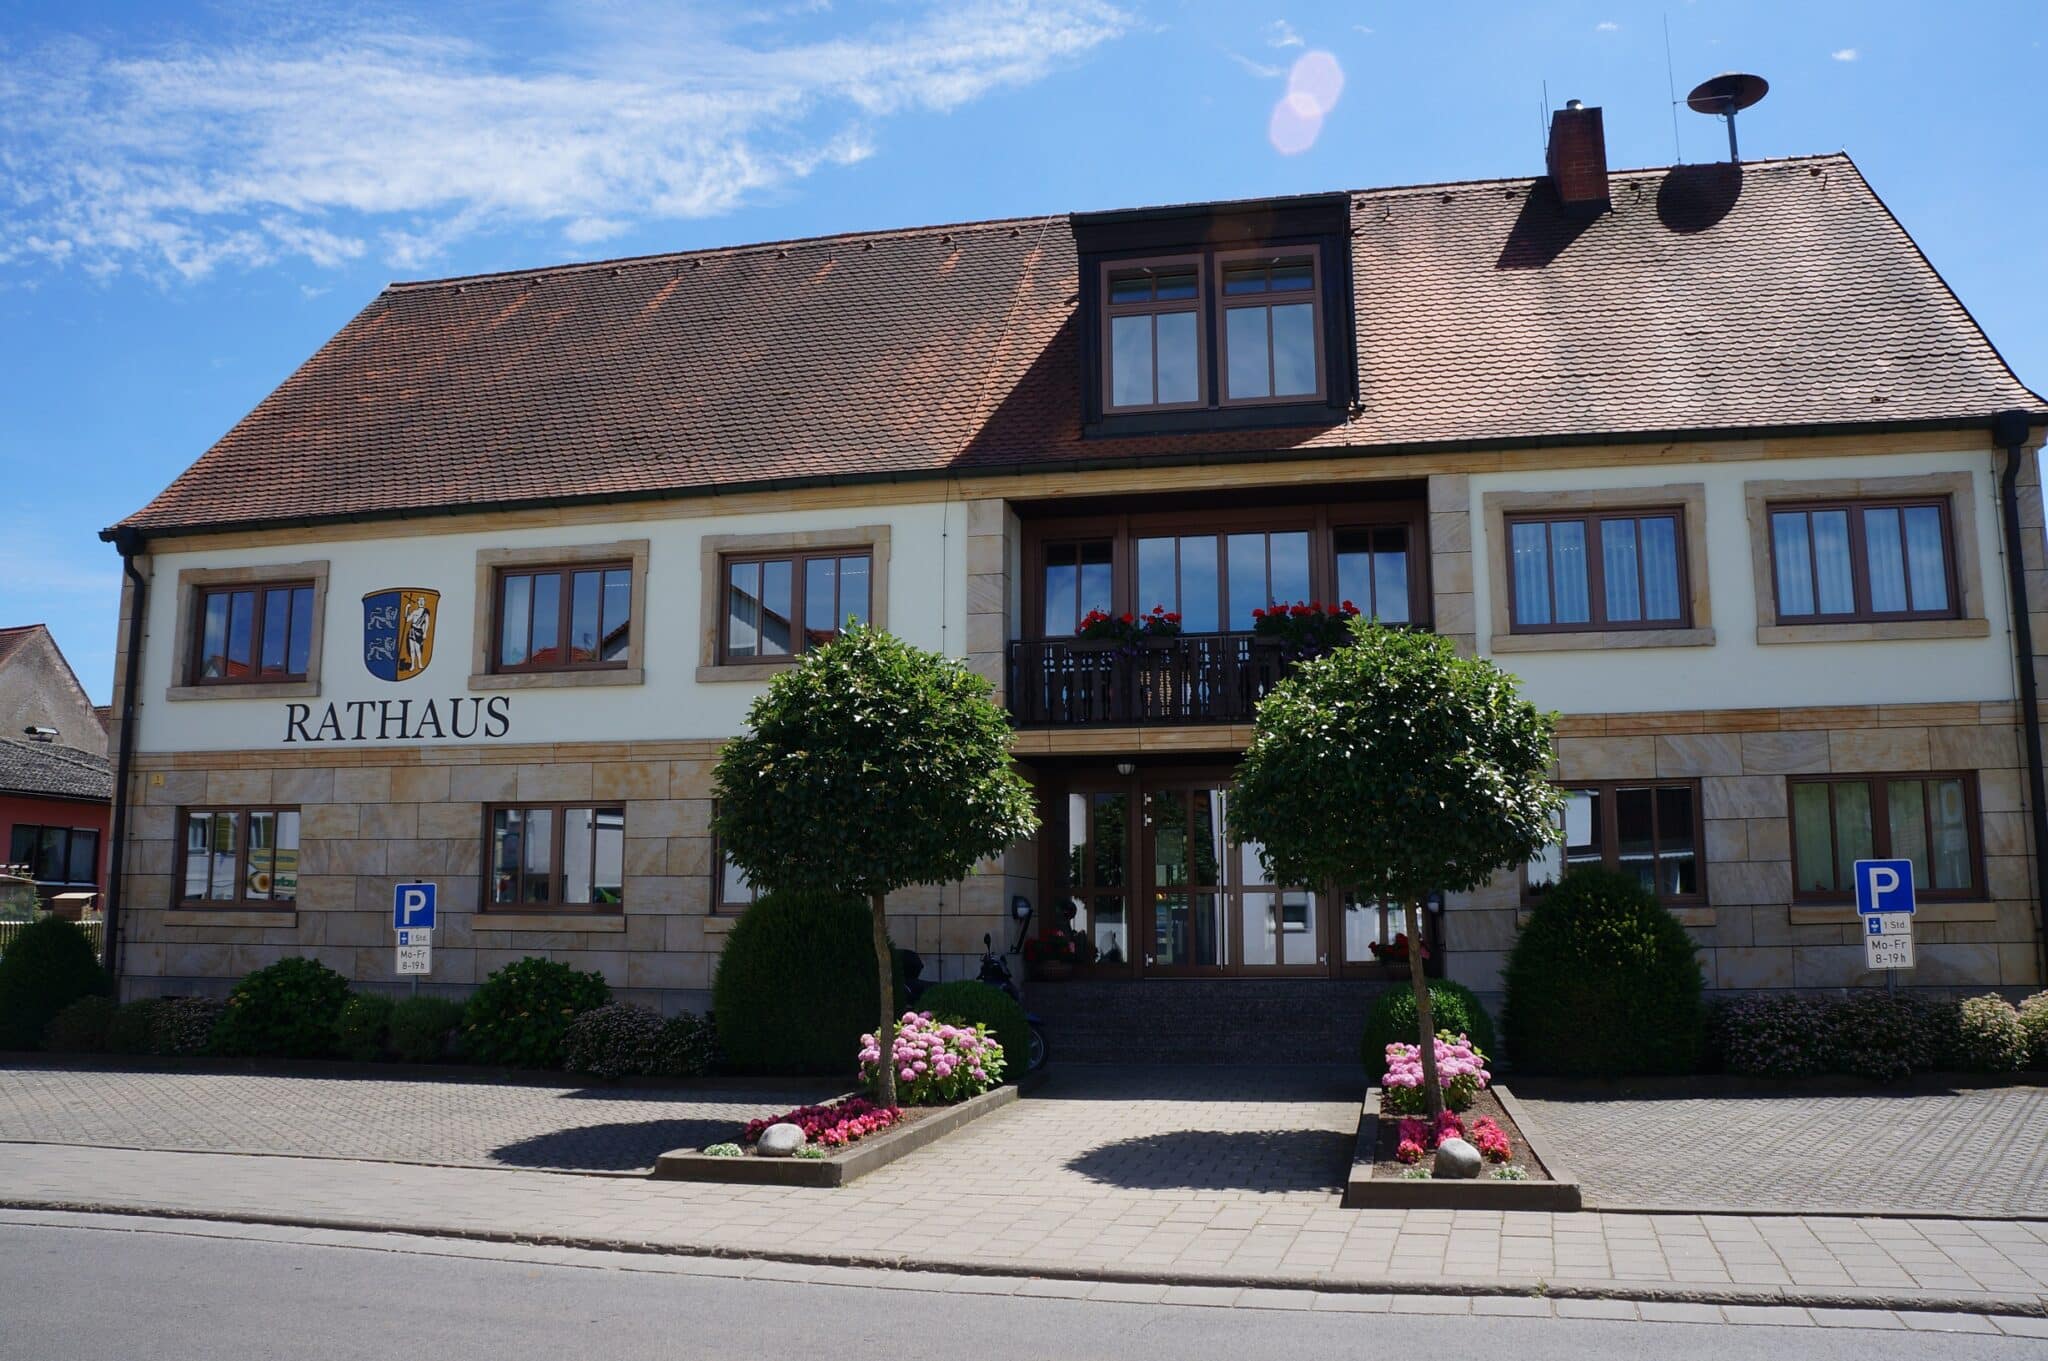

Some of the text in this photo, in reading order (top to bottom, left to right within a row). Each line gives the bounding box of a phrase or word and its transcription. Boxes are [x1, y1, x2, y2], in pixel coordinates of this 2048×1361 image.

[283, 696, 510, 742] RATHAUS
[404, 890, 426, 924] P
[1869, 867, 1899, 909] P
[1871, 939, 1907, 950] Mo-Fr
